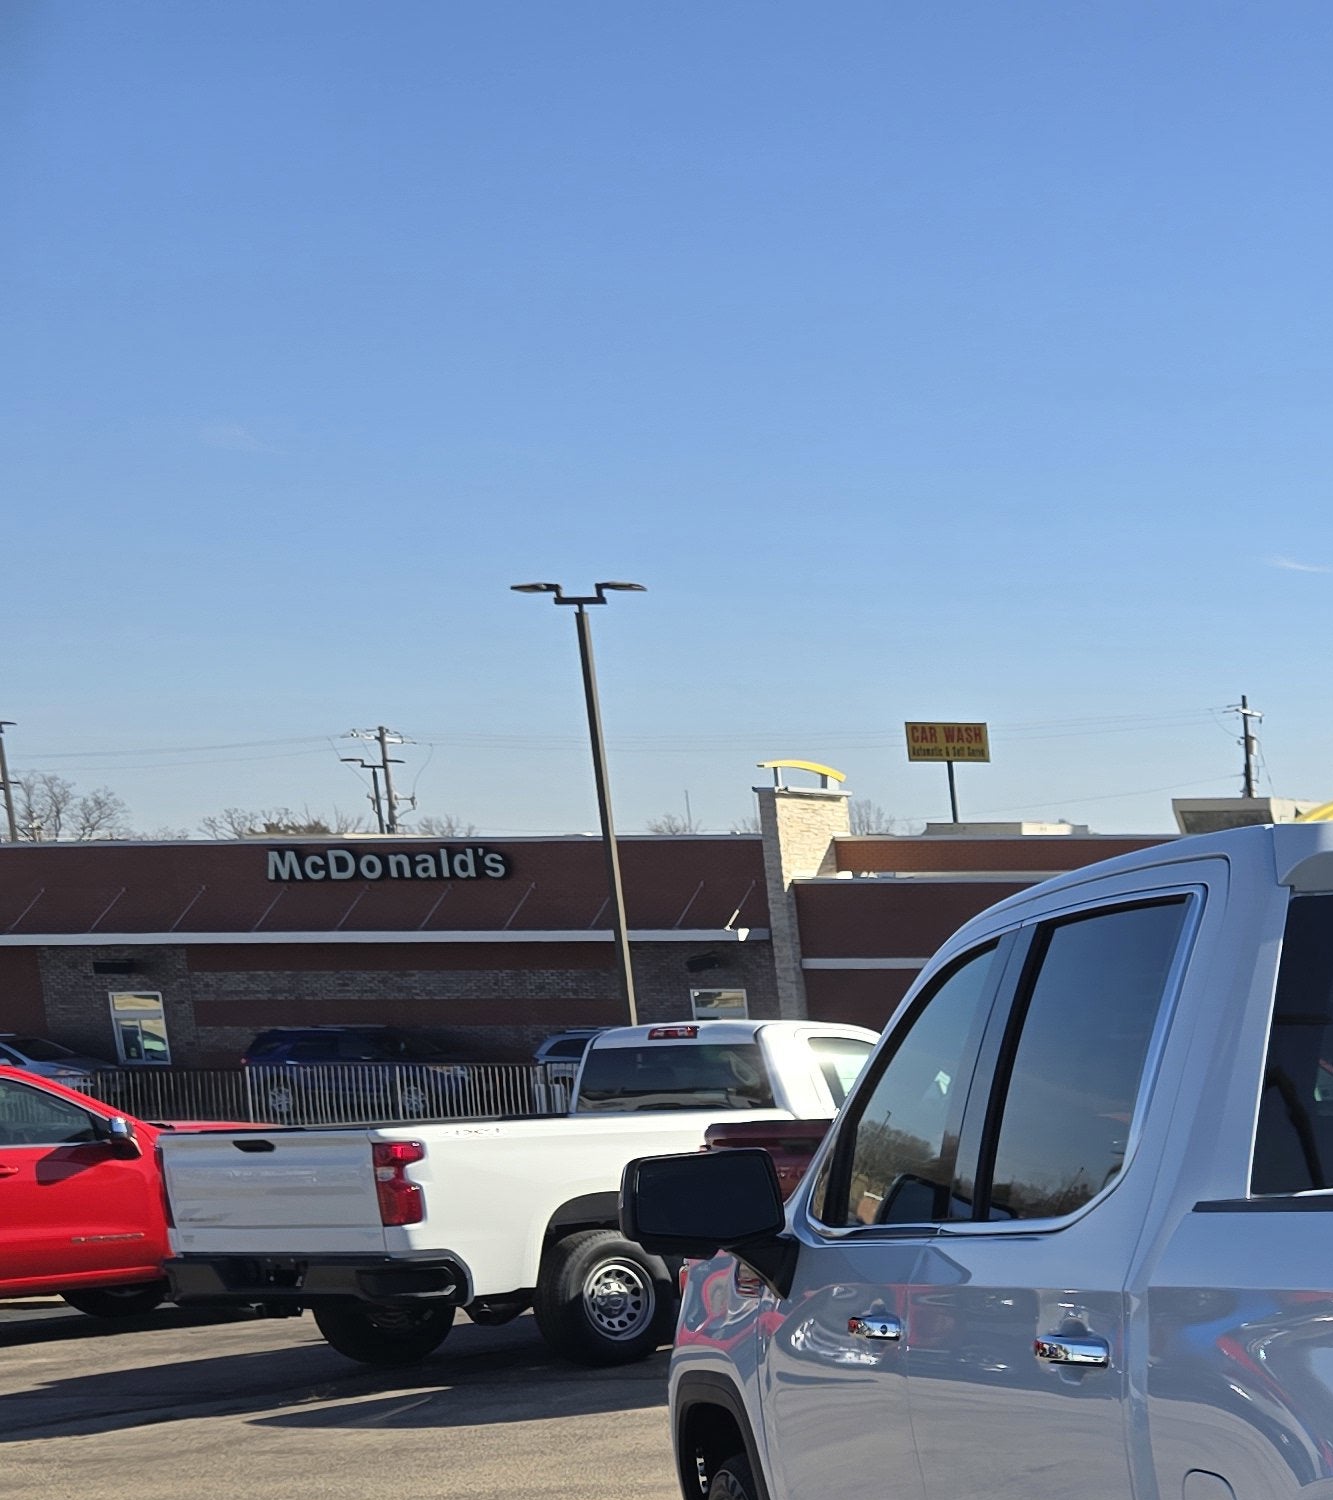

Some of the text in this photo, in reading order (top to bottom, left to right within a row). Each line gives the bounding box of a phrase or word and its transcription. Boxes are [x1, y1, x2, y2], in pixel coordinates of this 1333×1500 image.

[910, 725, 983, 744] CAR WASH
[267, 848, 506, 880] McDonald's
